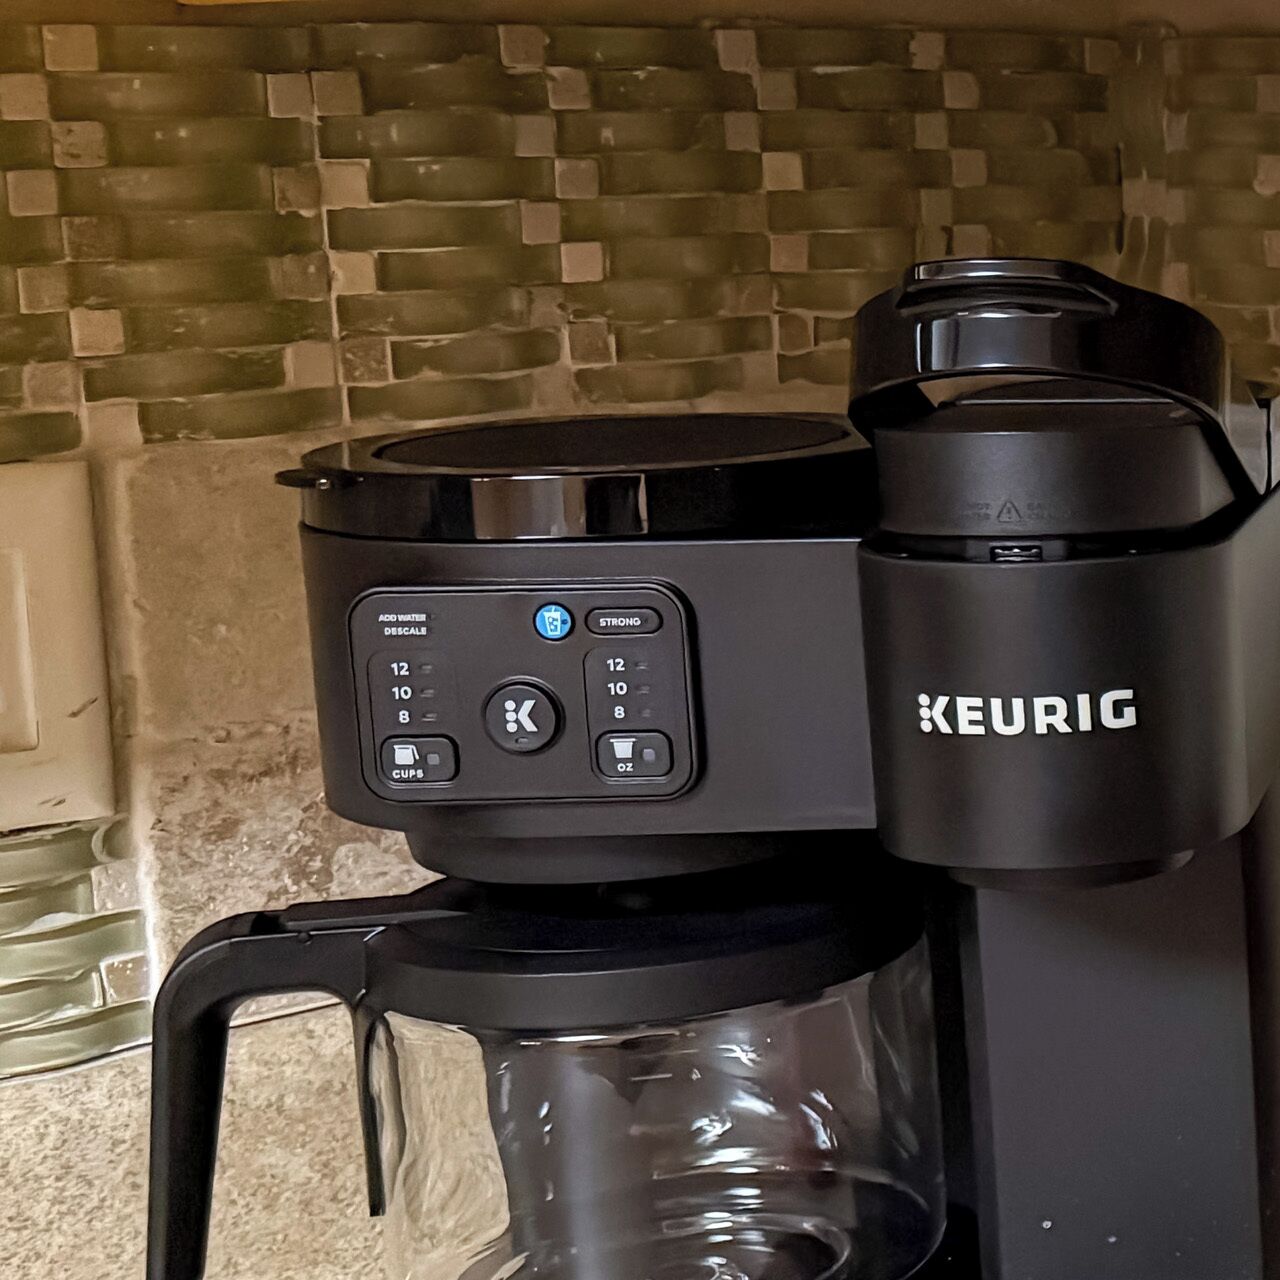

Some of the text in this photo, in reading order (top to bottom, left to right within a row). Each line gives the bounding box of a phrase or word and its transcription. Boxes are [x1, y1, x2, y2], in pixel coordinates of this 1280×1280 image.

[378, 613, 426, 622] ADD WATER
[599, 617, 641, 627] STRONG
[384, 626, 427, 635] DESCALE
[391, 662, 410, 675] 12
[606, 658, 625, 671] 12
[391, 686, 412, 700] 10
[607, 682, 627, 695] 10
[398, 710, 410, 723] 8
[613, 706, 625, 720] 8
[917, 688, 1137, 736] KEURIG
[392, 769, 424, 779] CUPS
[617, 763, 633, 772] OZ
